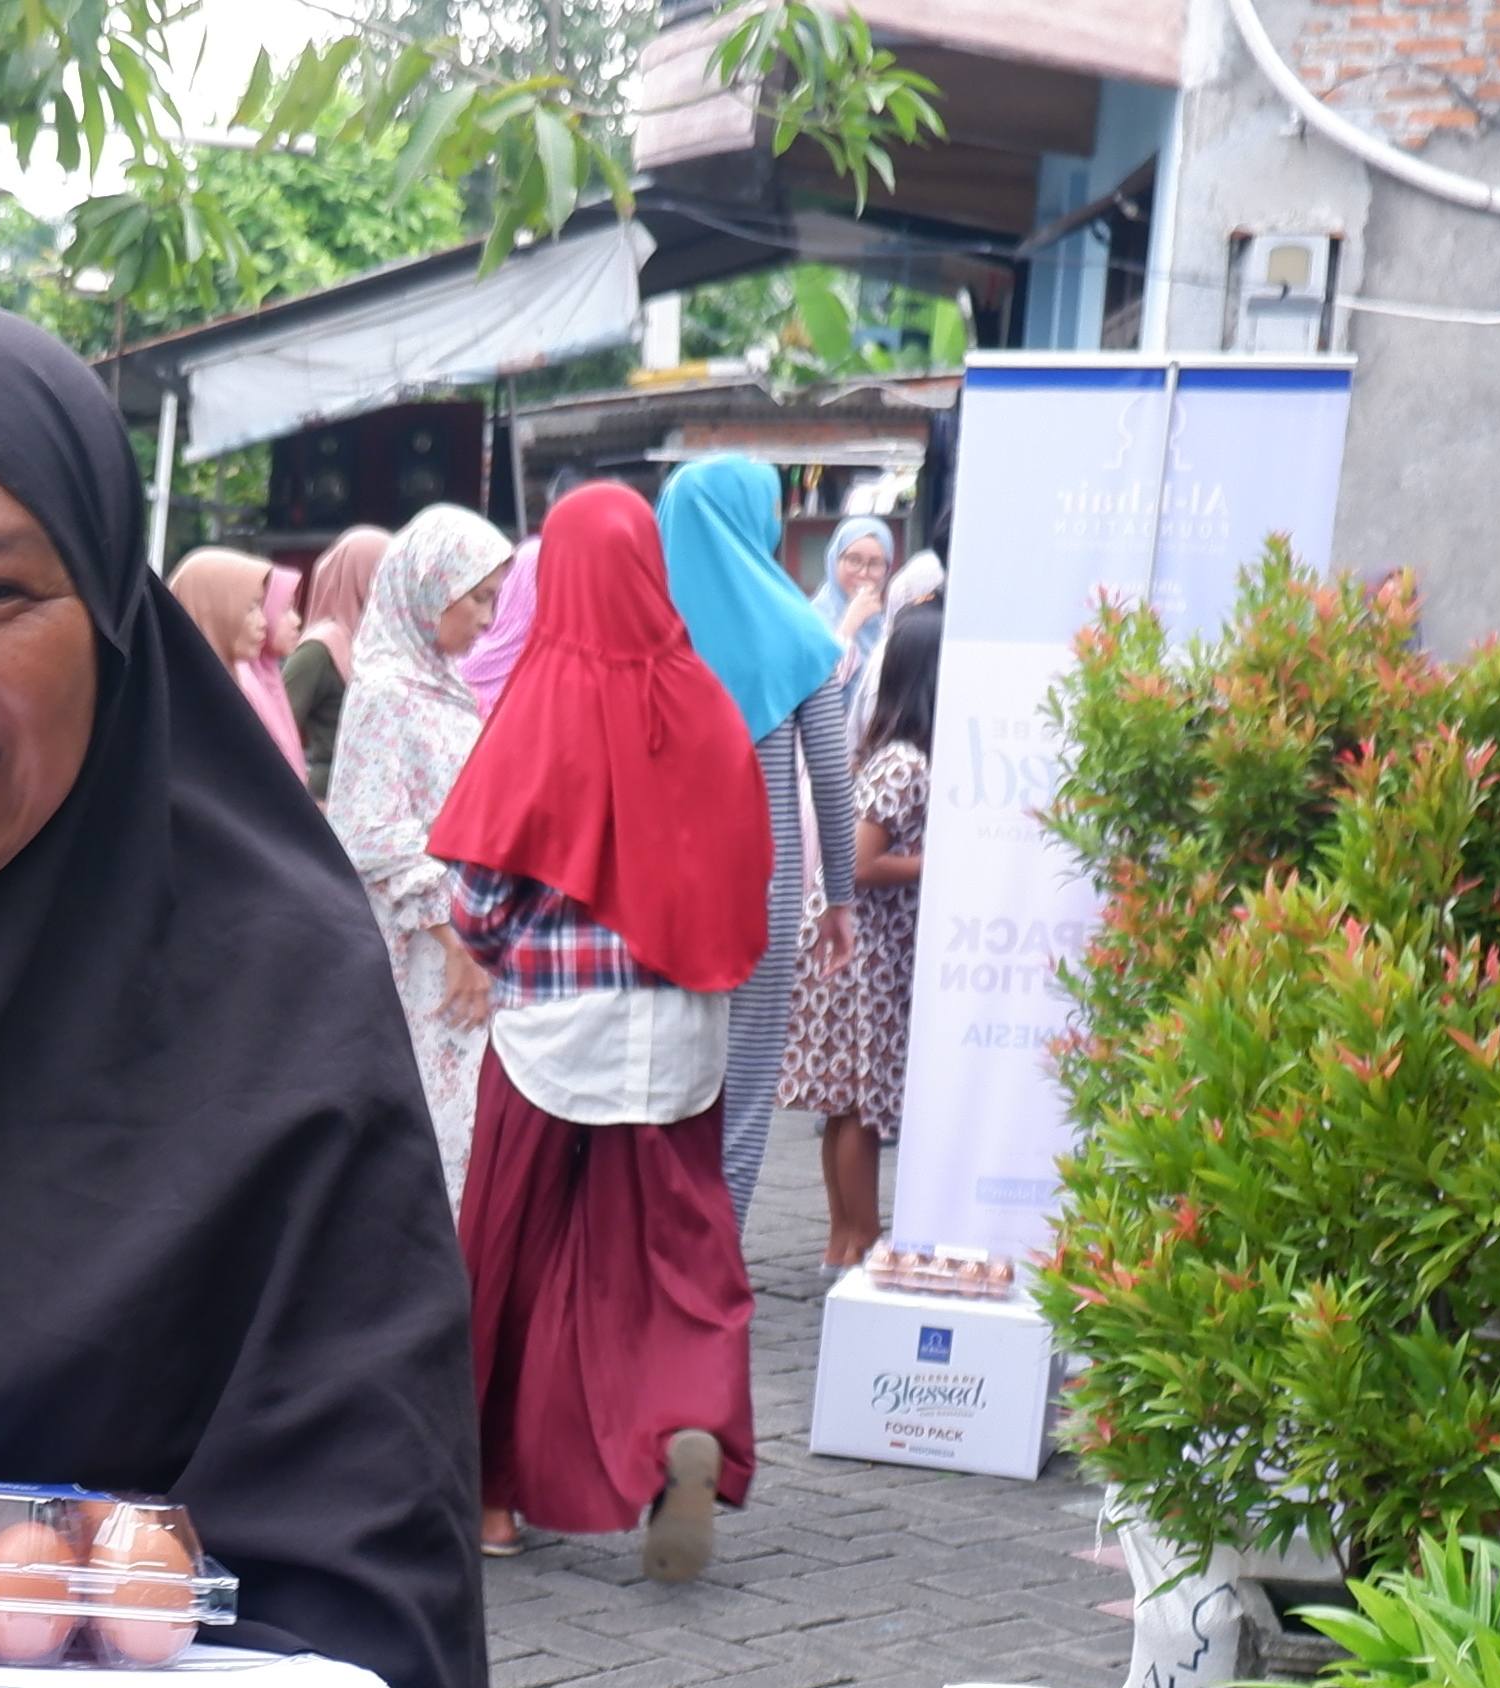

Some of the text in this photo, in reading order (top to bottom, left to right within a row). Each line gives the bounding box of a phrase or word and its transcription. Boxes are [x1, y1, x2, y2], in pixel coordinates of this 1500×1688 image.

[871, 1372, 987, 1415] Blessed
[885, 1420, 964, 1442] FOOD PACK
